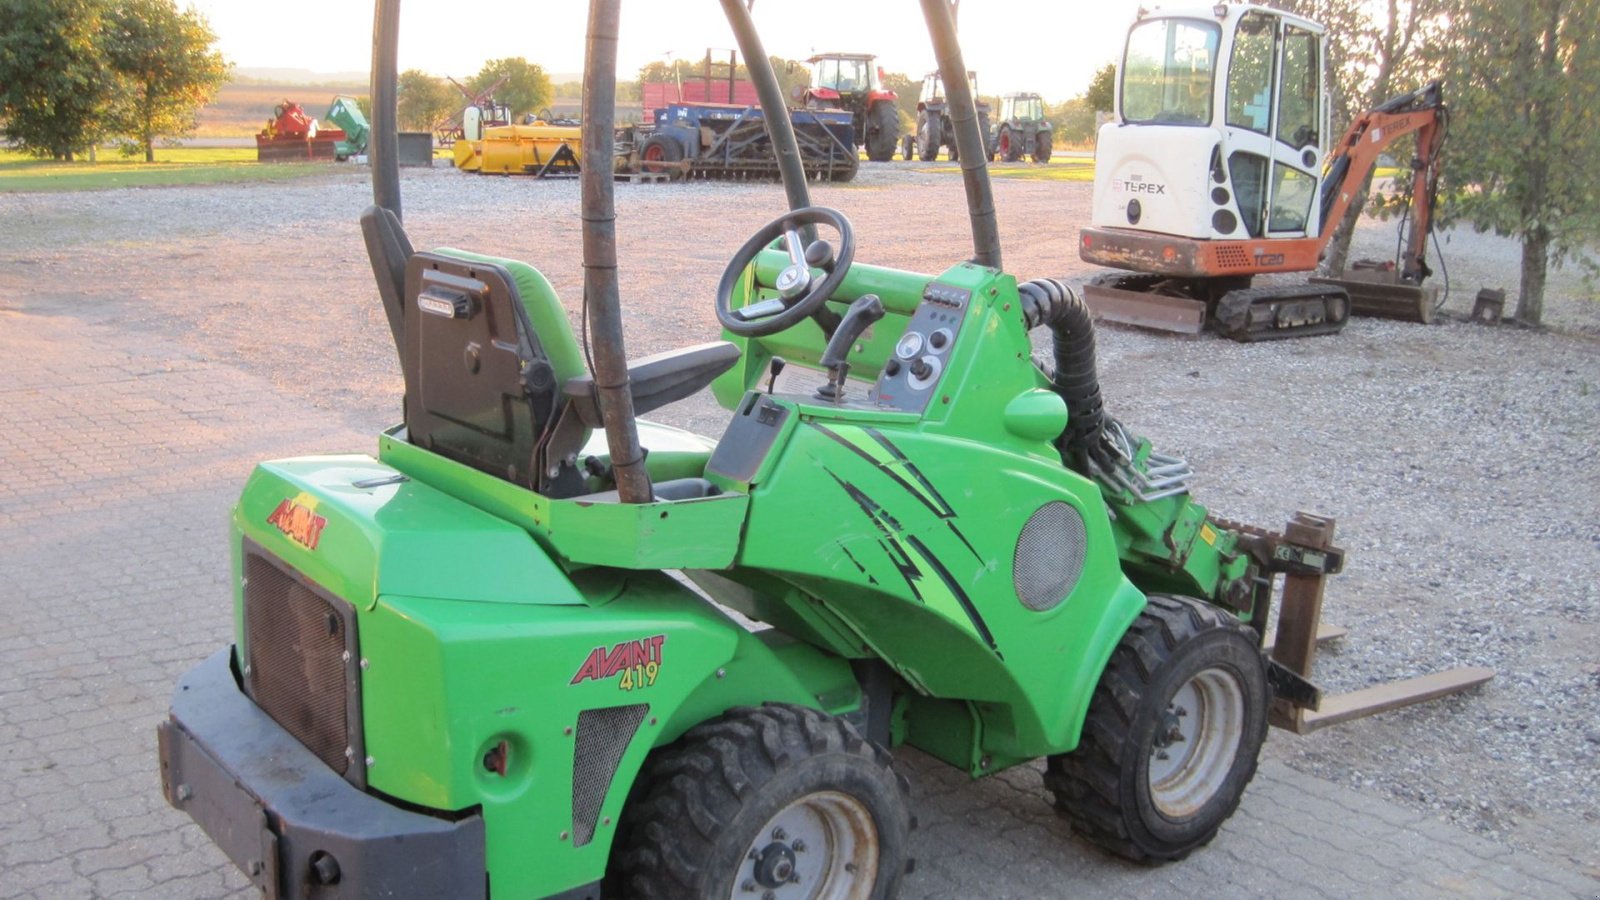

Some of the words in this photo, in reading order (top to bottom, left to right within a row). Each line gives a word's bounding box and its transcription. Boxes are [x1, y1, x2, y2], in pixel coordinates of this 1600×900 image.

[1124, 181, 1165, 195] TEREX
[1254, 254, 1285, 266] TC20
[266, 497, 328, 551] AVANT
[568, 634, 667, 686] AVANT
[619, 661, 658, 691] 419
